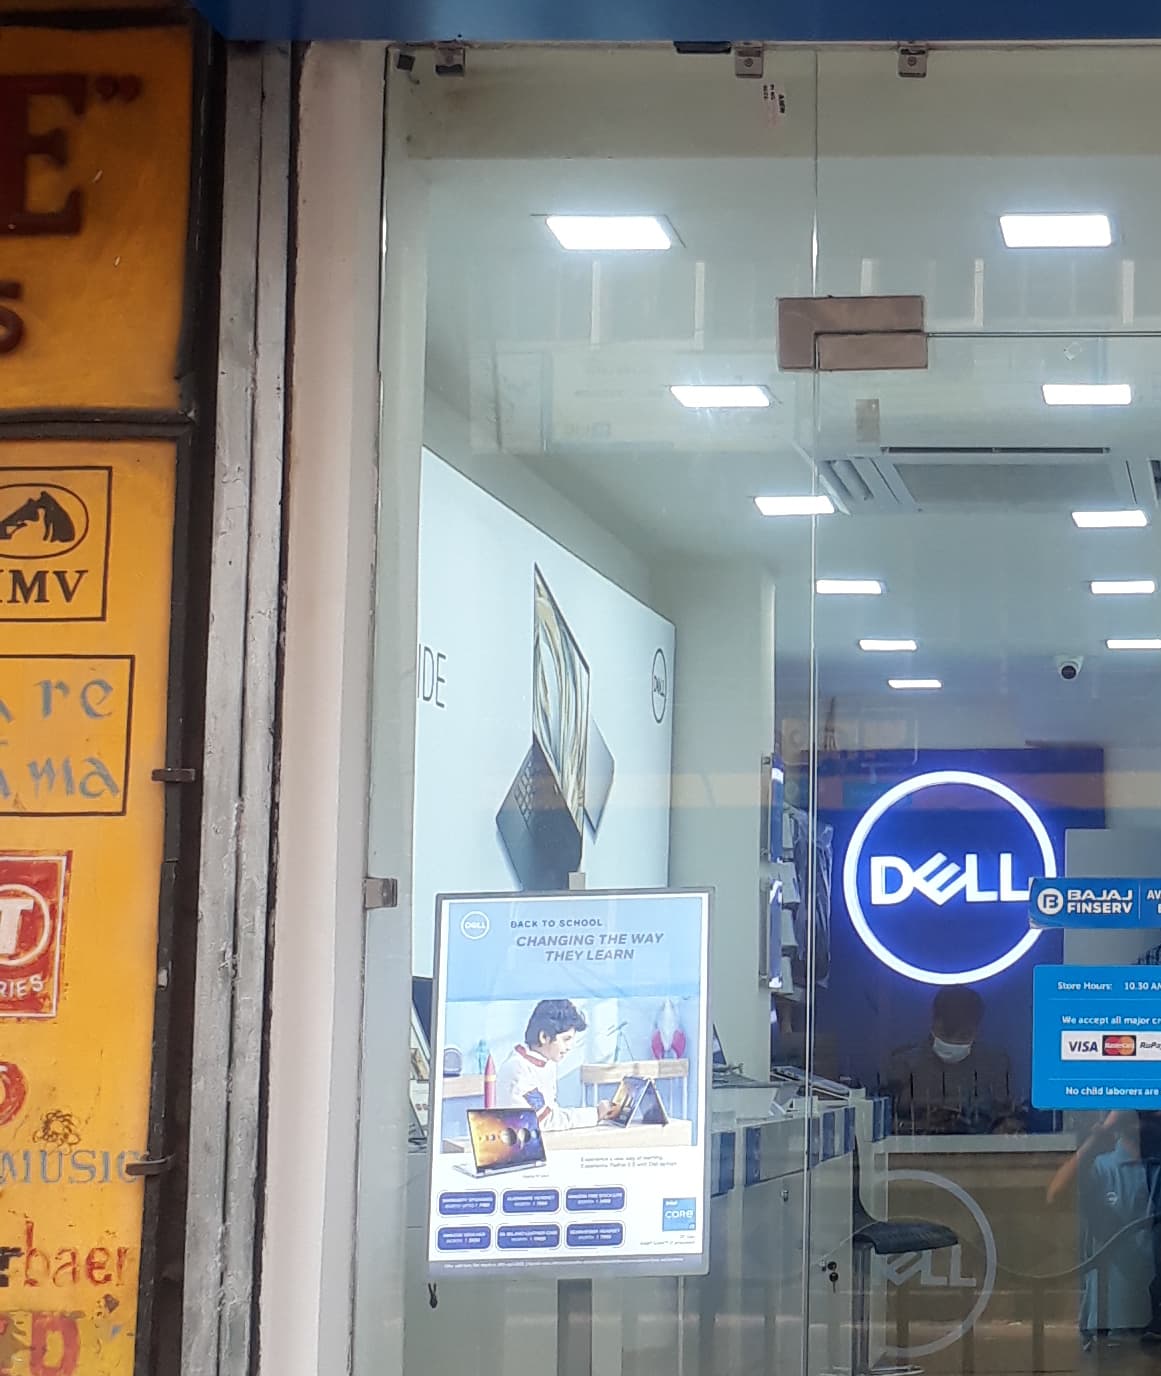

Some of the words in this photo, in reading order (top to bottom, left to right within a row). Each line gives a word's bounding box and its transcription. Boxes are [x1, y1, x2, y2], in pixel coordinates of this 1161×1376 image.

[0, 568, 89, 605] MV
[869, 851, 1030, 907] DELL
[1066, 889, 1133, 902] BAJAJ
[1066, 902, 1133, 915] FINSERV
[510, 920, 538, 929] BACK
[542, 920, 555, 928] TO
[559, 918, 603, 928] SCHOOL
[515, 934, 595, 948] CHANGING
[599, 933, 628, 946] THE
[631, 932, 664, 945] WAY
[545, 949, 583, 962] THEY
[586, 948, 635, 962] LEARN
[1057, 981, 1082, 991] Store
[1083, 981, 1113, 991] Hours:
[1123, 981, 1149, 991] 10.30
[1061, 1015, 1076, 1025] We
[1078, 1015, 1110, 1027] accept
[1110, 1015, 1122, 1025] all
[1123, 1015, 1150, 1027] major
[1068, 1040, 1099, 1053] VISA
[1065, 1086, 1078, 1096] No
[1080, 1086, 1104, 1096] child
[1105, 1086, 1143, 1096] laborers
[1144, 1087, 1159, 1096] are
